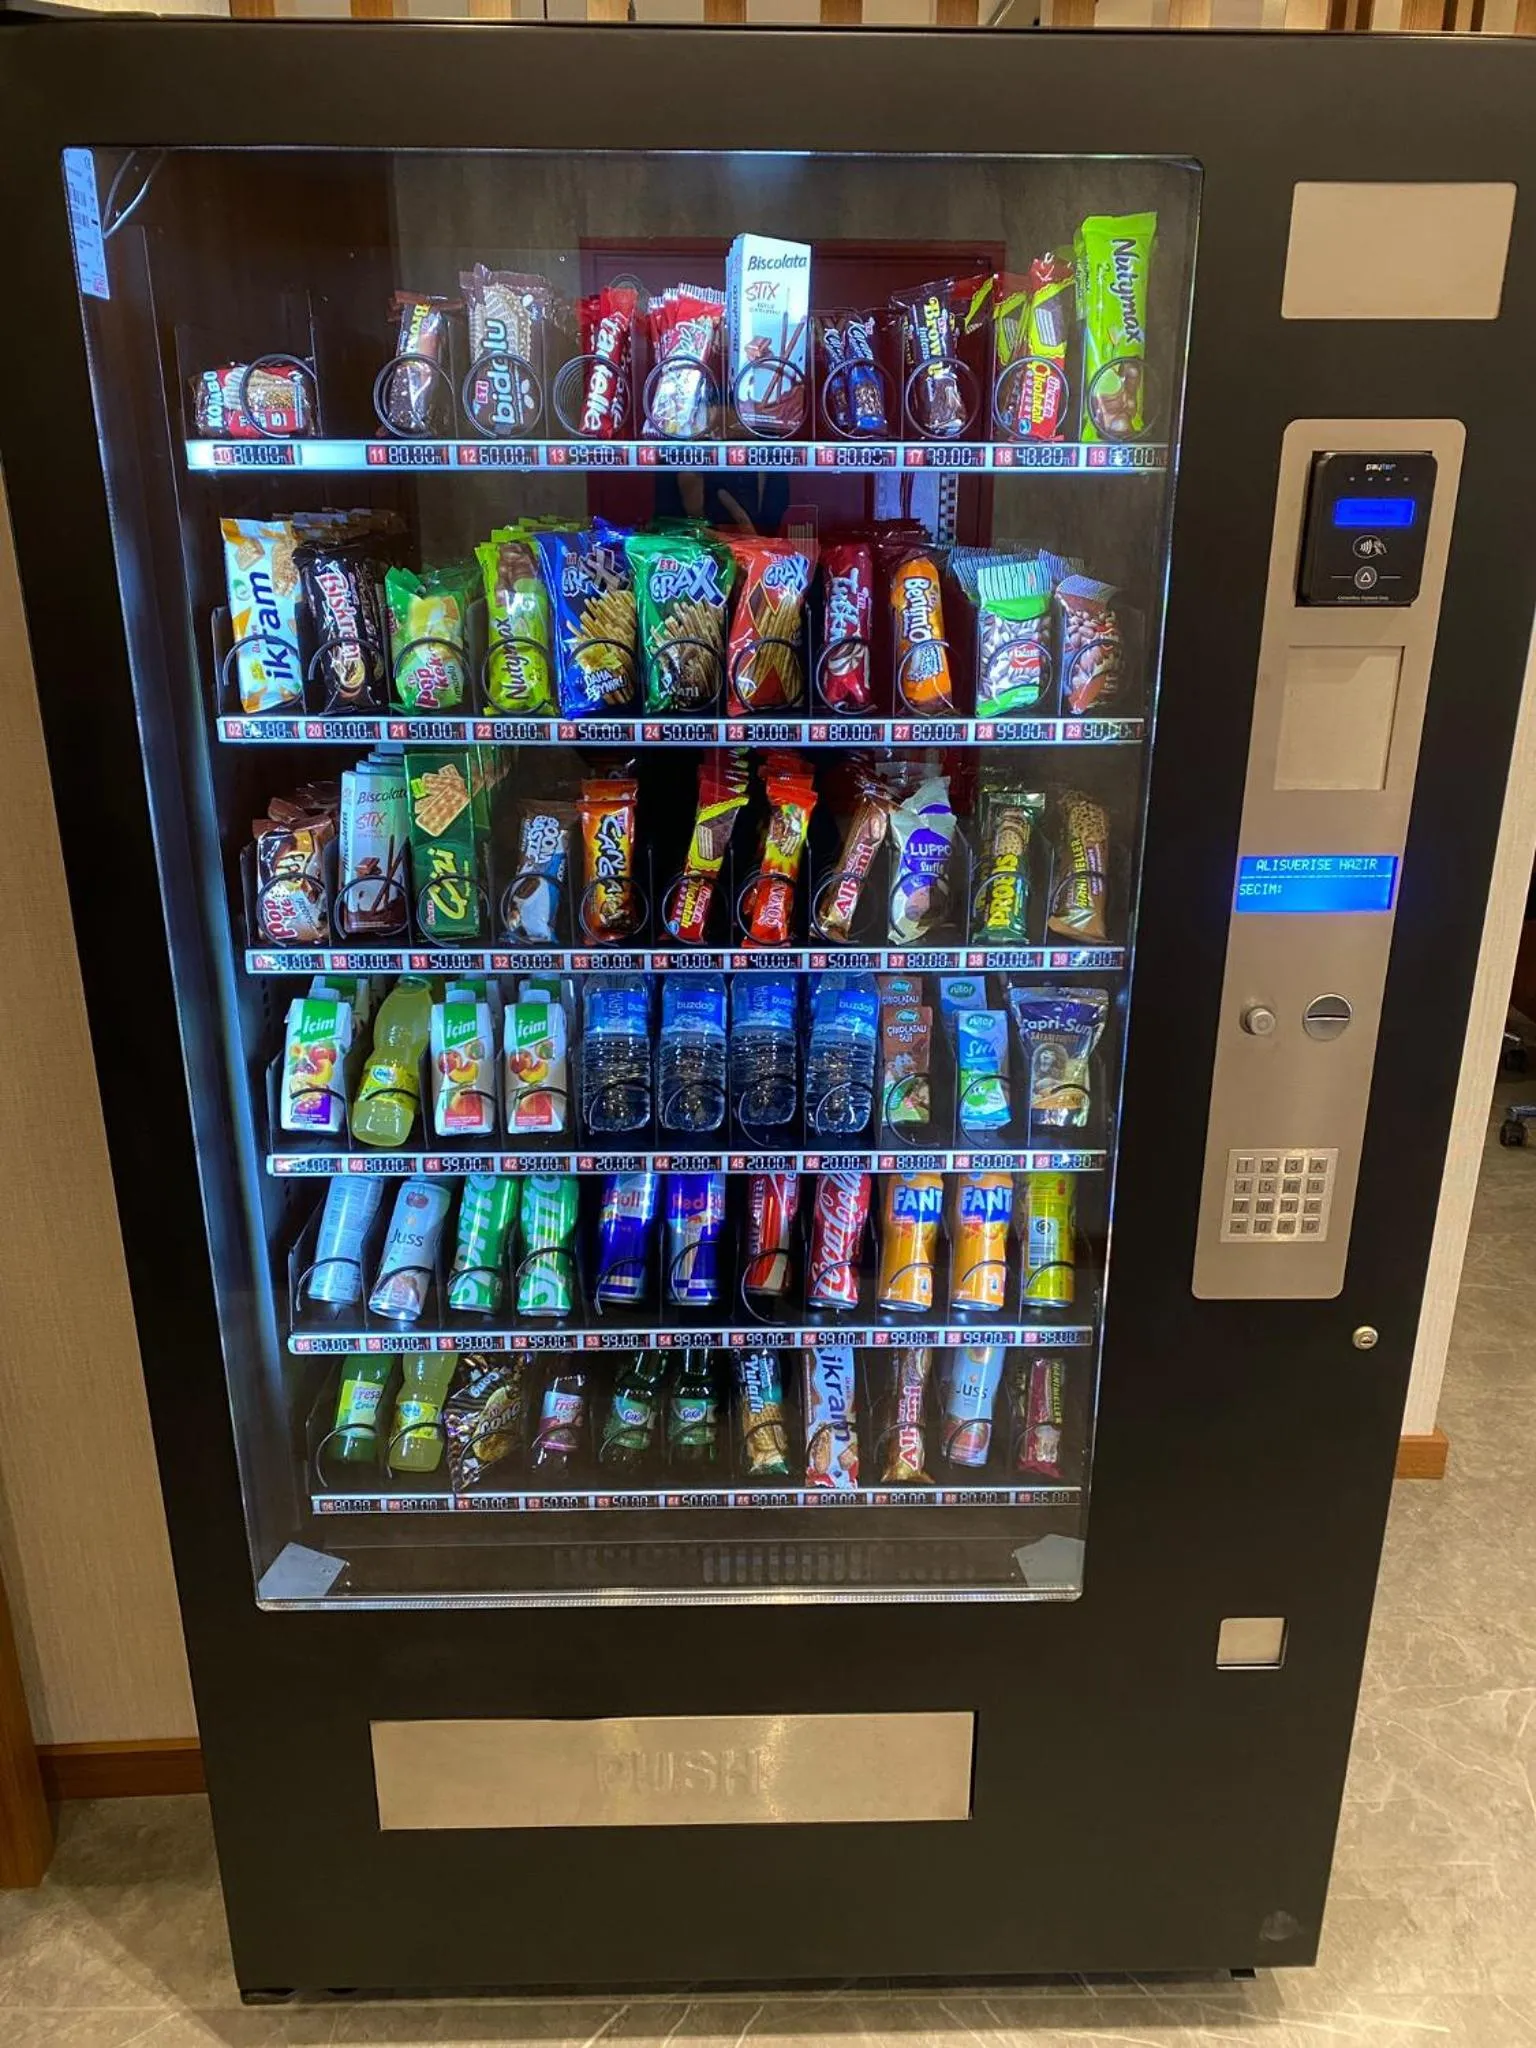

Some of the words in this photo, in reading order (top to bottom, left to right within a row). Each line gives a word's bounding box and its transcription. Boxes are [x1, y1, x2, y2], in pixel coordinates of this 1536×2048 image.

[747, 253, 808, 271] Biscolata
[1109, 238, 1144, 345] Nutymax
[650, 554, 727, 609] CRAX
[762, 551, 811, 592] CRAX
[1256, 858, 1332, 872] ALISVERISE
[892, 1186, 943, 1212] FANT
[960, 1186, 1013, 1212] FANT
[597, 1748, 761, 1796] PUSH
